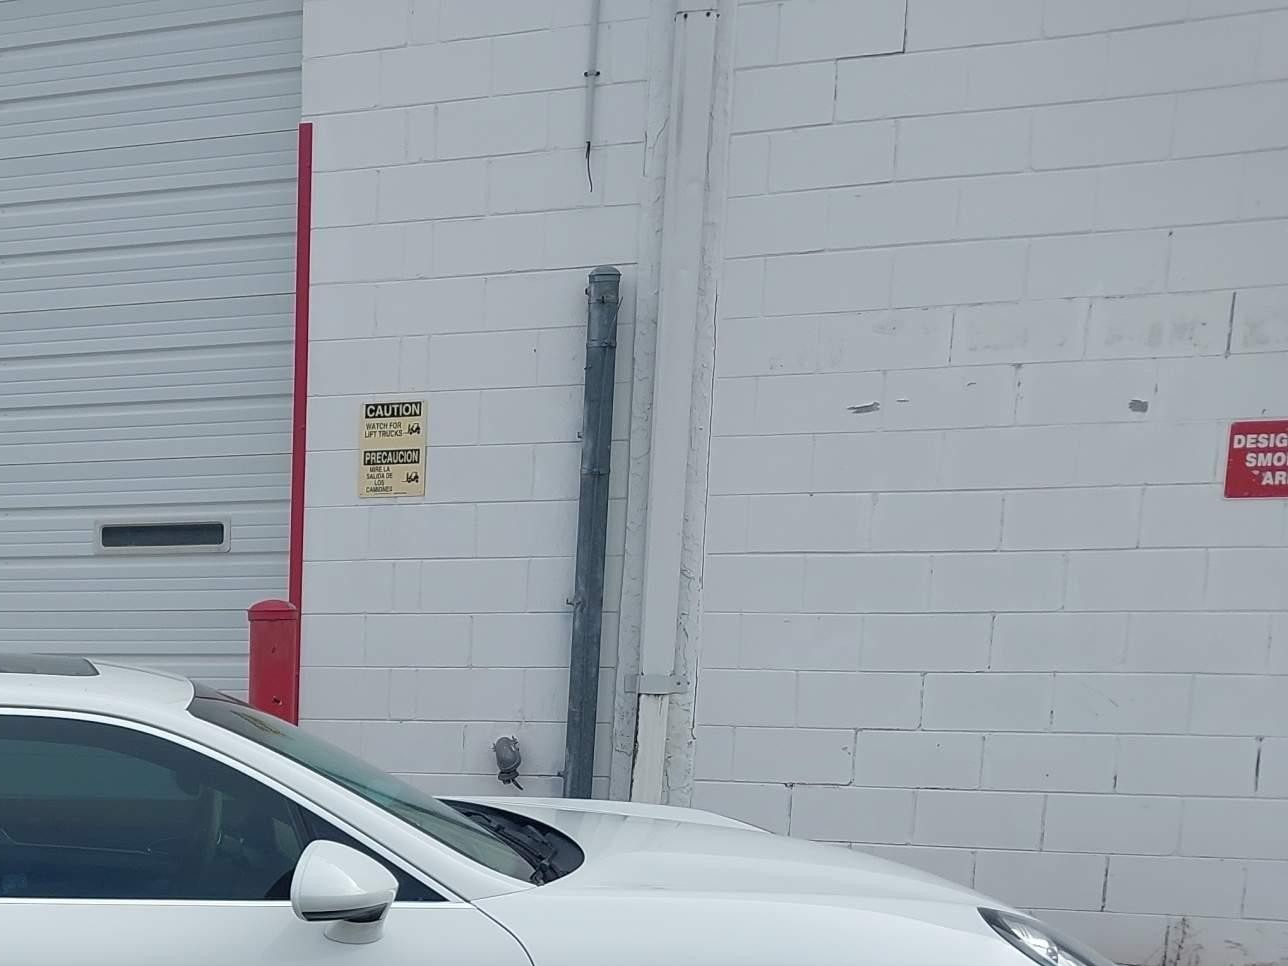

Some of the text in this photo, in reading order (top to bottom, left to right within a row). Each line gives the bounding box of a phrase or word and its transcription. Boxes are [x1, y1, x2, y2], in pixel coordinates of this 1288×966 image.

[367, 403, 421, 417] CAUTION
[365, 422, 387, 430] WATCH
[364, 430, 403, 438] LIFT TRUCKS
[365, 450, 419, 464] PRECAUCION
[1245, 451, 1288, 467] SMO
[1261, 470, 1288, 485] AR
